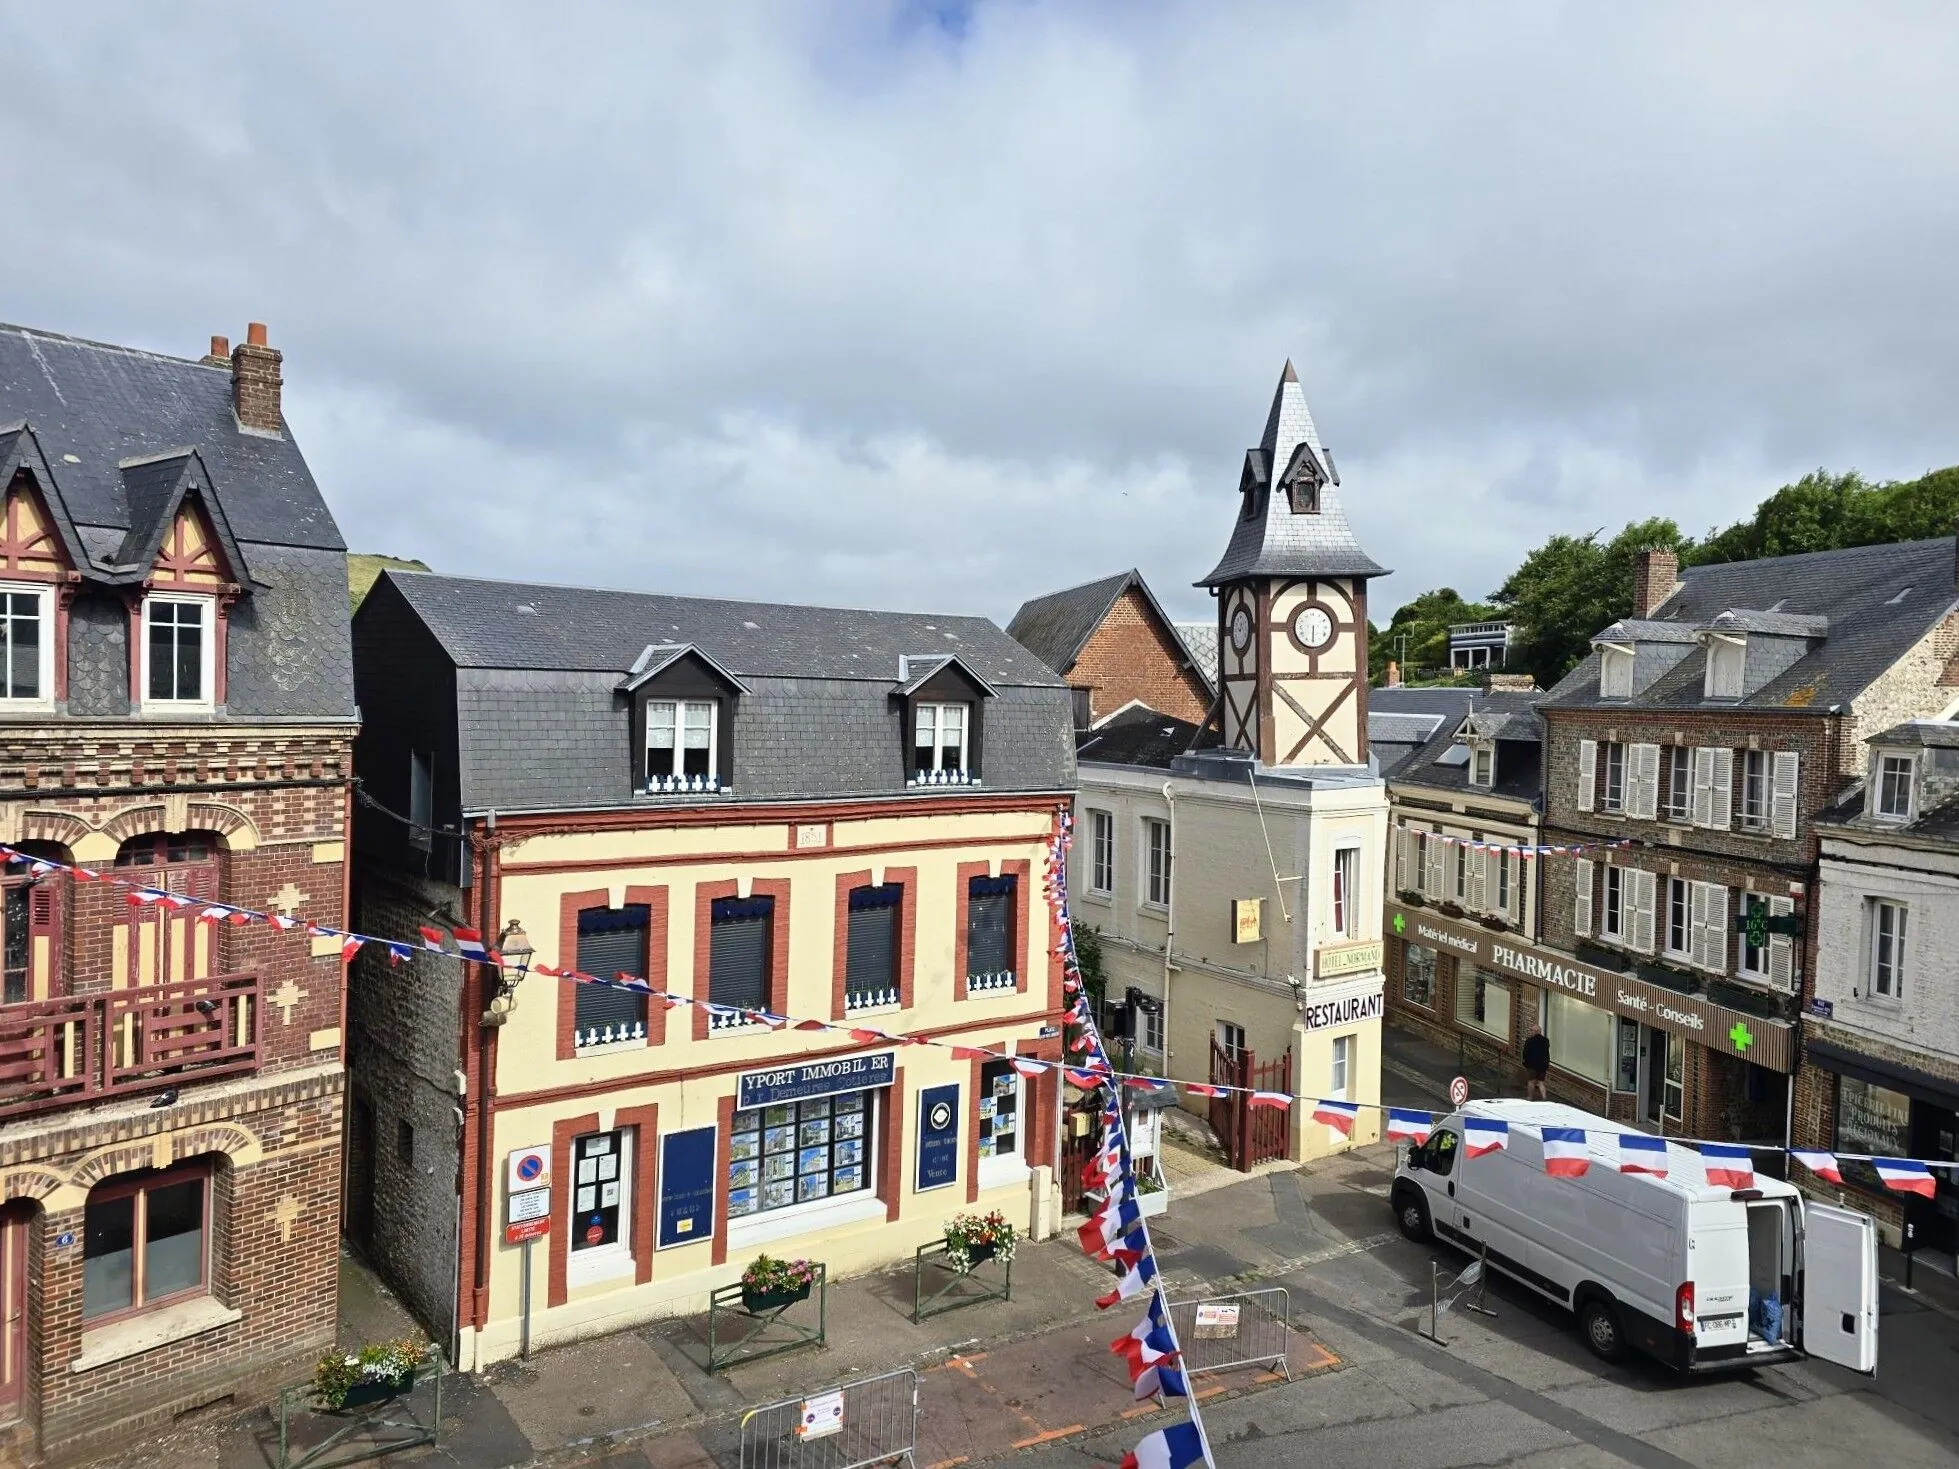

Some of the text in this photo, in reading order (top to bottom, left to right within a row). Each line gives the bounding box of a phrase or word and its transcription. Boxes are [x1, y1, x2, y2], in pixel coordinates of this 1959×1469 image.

[1418, 925, 1478, 954] Matériel médical
[1492, 945, 1596, 997] PHARMACIE
[1306, 993, 1383, 1029] RESTAURANT
[1617, 989, 1648, 1011] Santé
[1656, 1003, 1704, 1030] Conseils
[745, 1070, 796, 1090] YPORT
